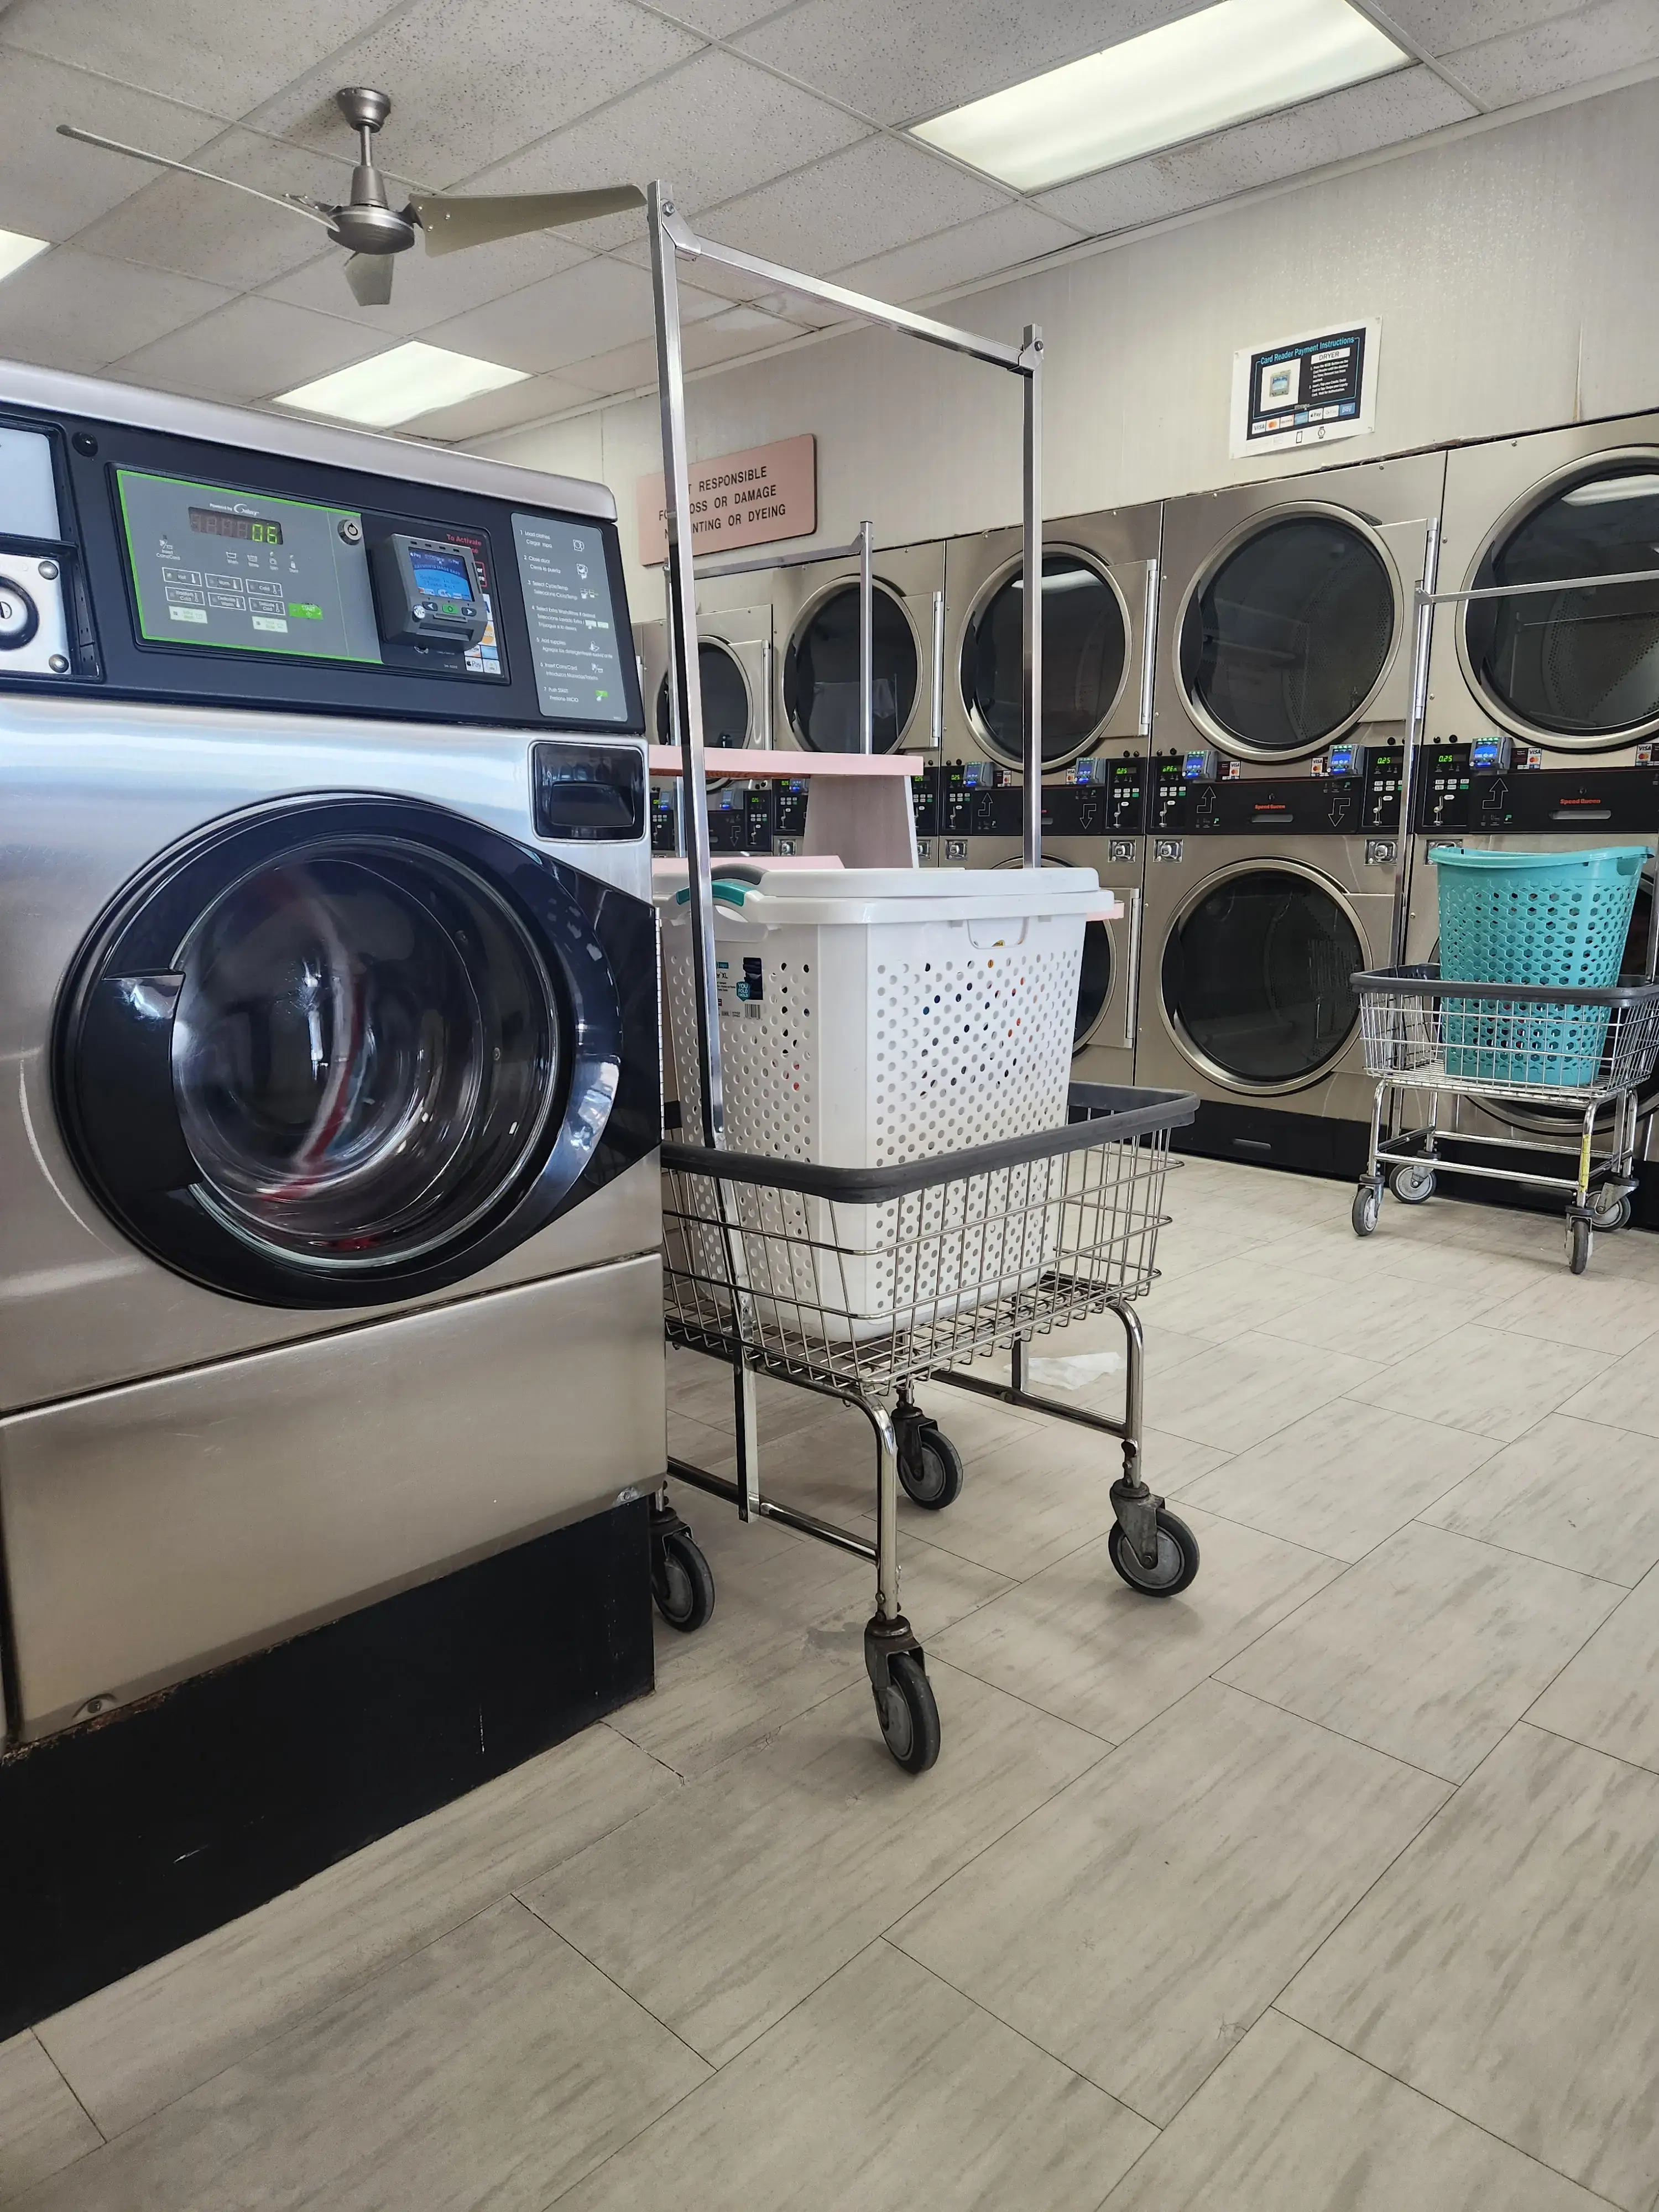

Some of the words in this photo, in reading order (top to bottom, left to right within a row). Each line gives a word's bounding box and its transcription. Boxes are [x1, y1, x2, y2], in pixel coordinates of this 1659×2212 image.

[1261, 355, 1273, 364] Card
[1274, 351, 1293, 361] Reader
[1295, 345, 1318, 358] Payment
[1320, 337, 1354, 348] Instructions
[1319, 351, 1339, 360] DRYER
[698, 466, 767, 492] RESPONSIBLE
[233, 503, 258, 516] Galaxy
[689, 500, 708, 514] OSS
[714, 496, 728, 509] OR
[734, 484, 776, 504] DAMAGE
[728, 514, 742, 526] OR
[748, 504, 786, 522] DYEING
[252, 523, 278, 544] 06
[456, 536, 482, 546] Activate
